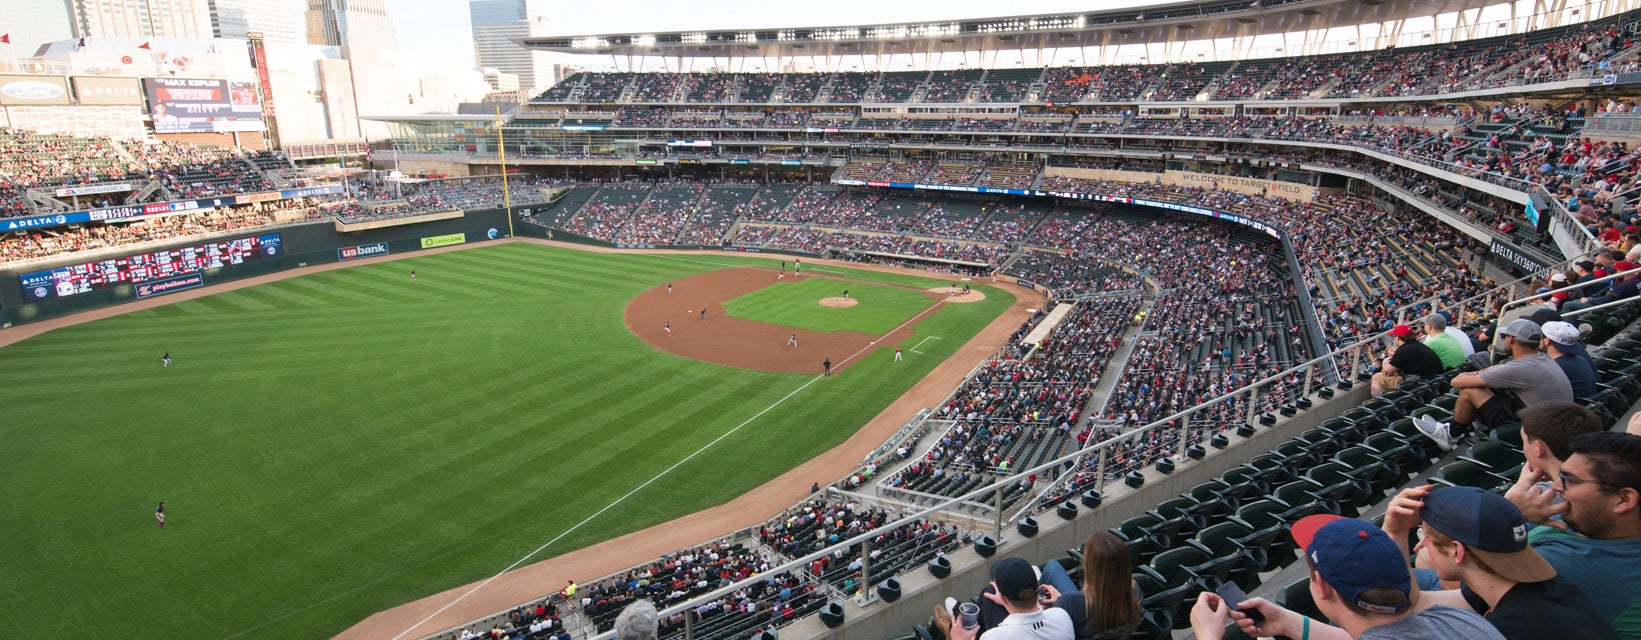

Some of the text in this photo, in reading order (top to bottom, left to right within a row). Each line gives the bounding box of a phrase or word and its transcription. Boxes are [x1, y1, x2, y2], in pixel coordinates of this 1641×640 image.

[164, 79, 187, 87] MAX
[14, 87, 52, 97] Ford
[95, 87, 138, 96] DELTA
[1183, 174, 1225, 183] WELCOME
[1240, 179, 1271, 189] TARGET
[1277, 184, 1301, 194] FIELD
[77, 185, 125, 194] SUPERAMERICA
[19, 217, 53, 227] DELTA
[1496, 244, 1513, 261] DELTA
[29, 275, 54, 283] DELTA
